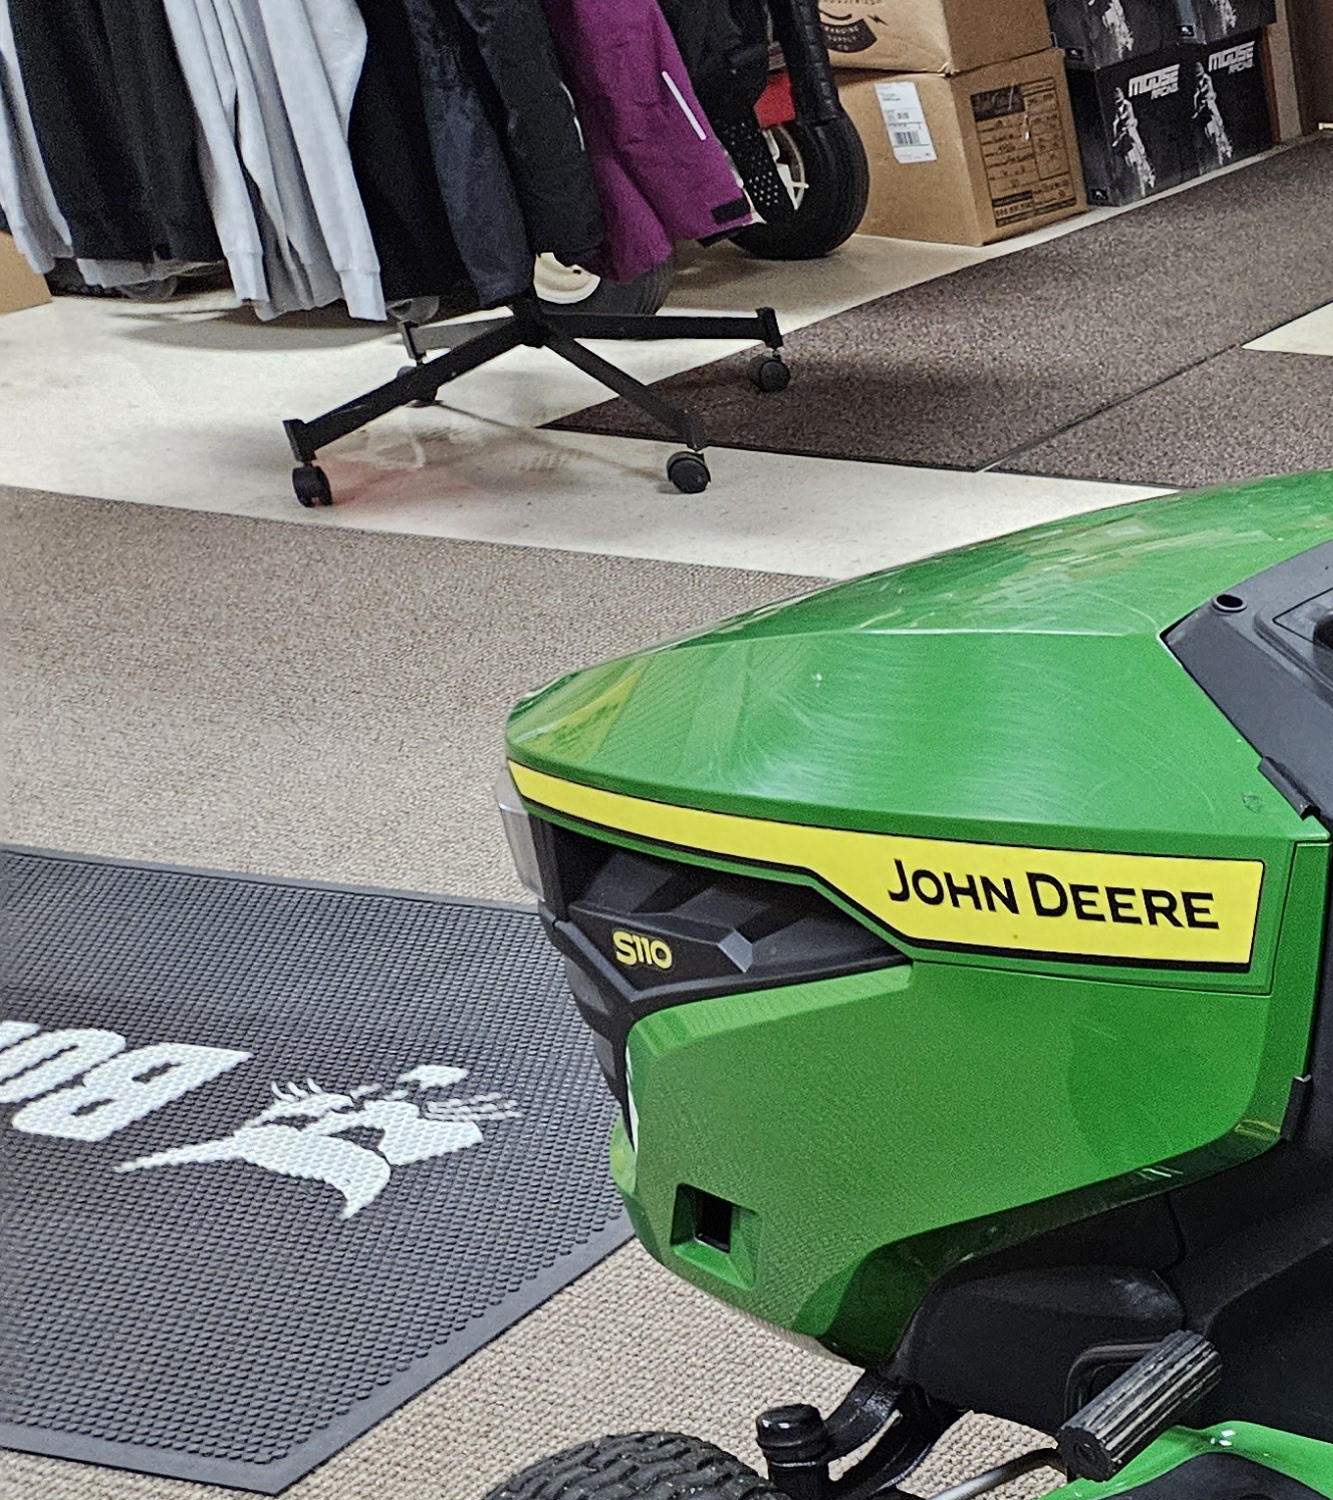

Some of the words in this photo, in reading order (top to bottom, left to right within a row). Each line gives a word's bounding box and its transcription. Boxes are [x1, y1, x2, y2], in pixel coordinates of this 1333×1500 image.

[1208, 41, 1256, 72] MOOSE
[1128, 64, 1181, 98] MOOSE
[612, 930, 672, 970] S110
